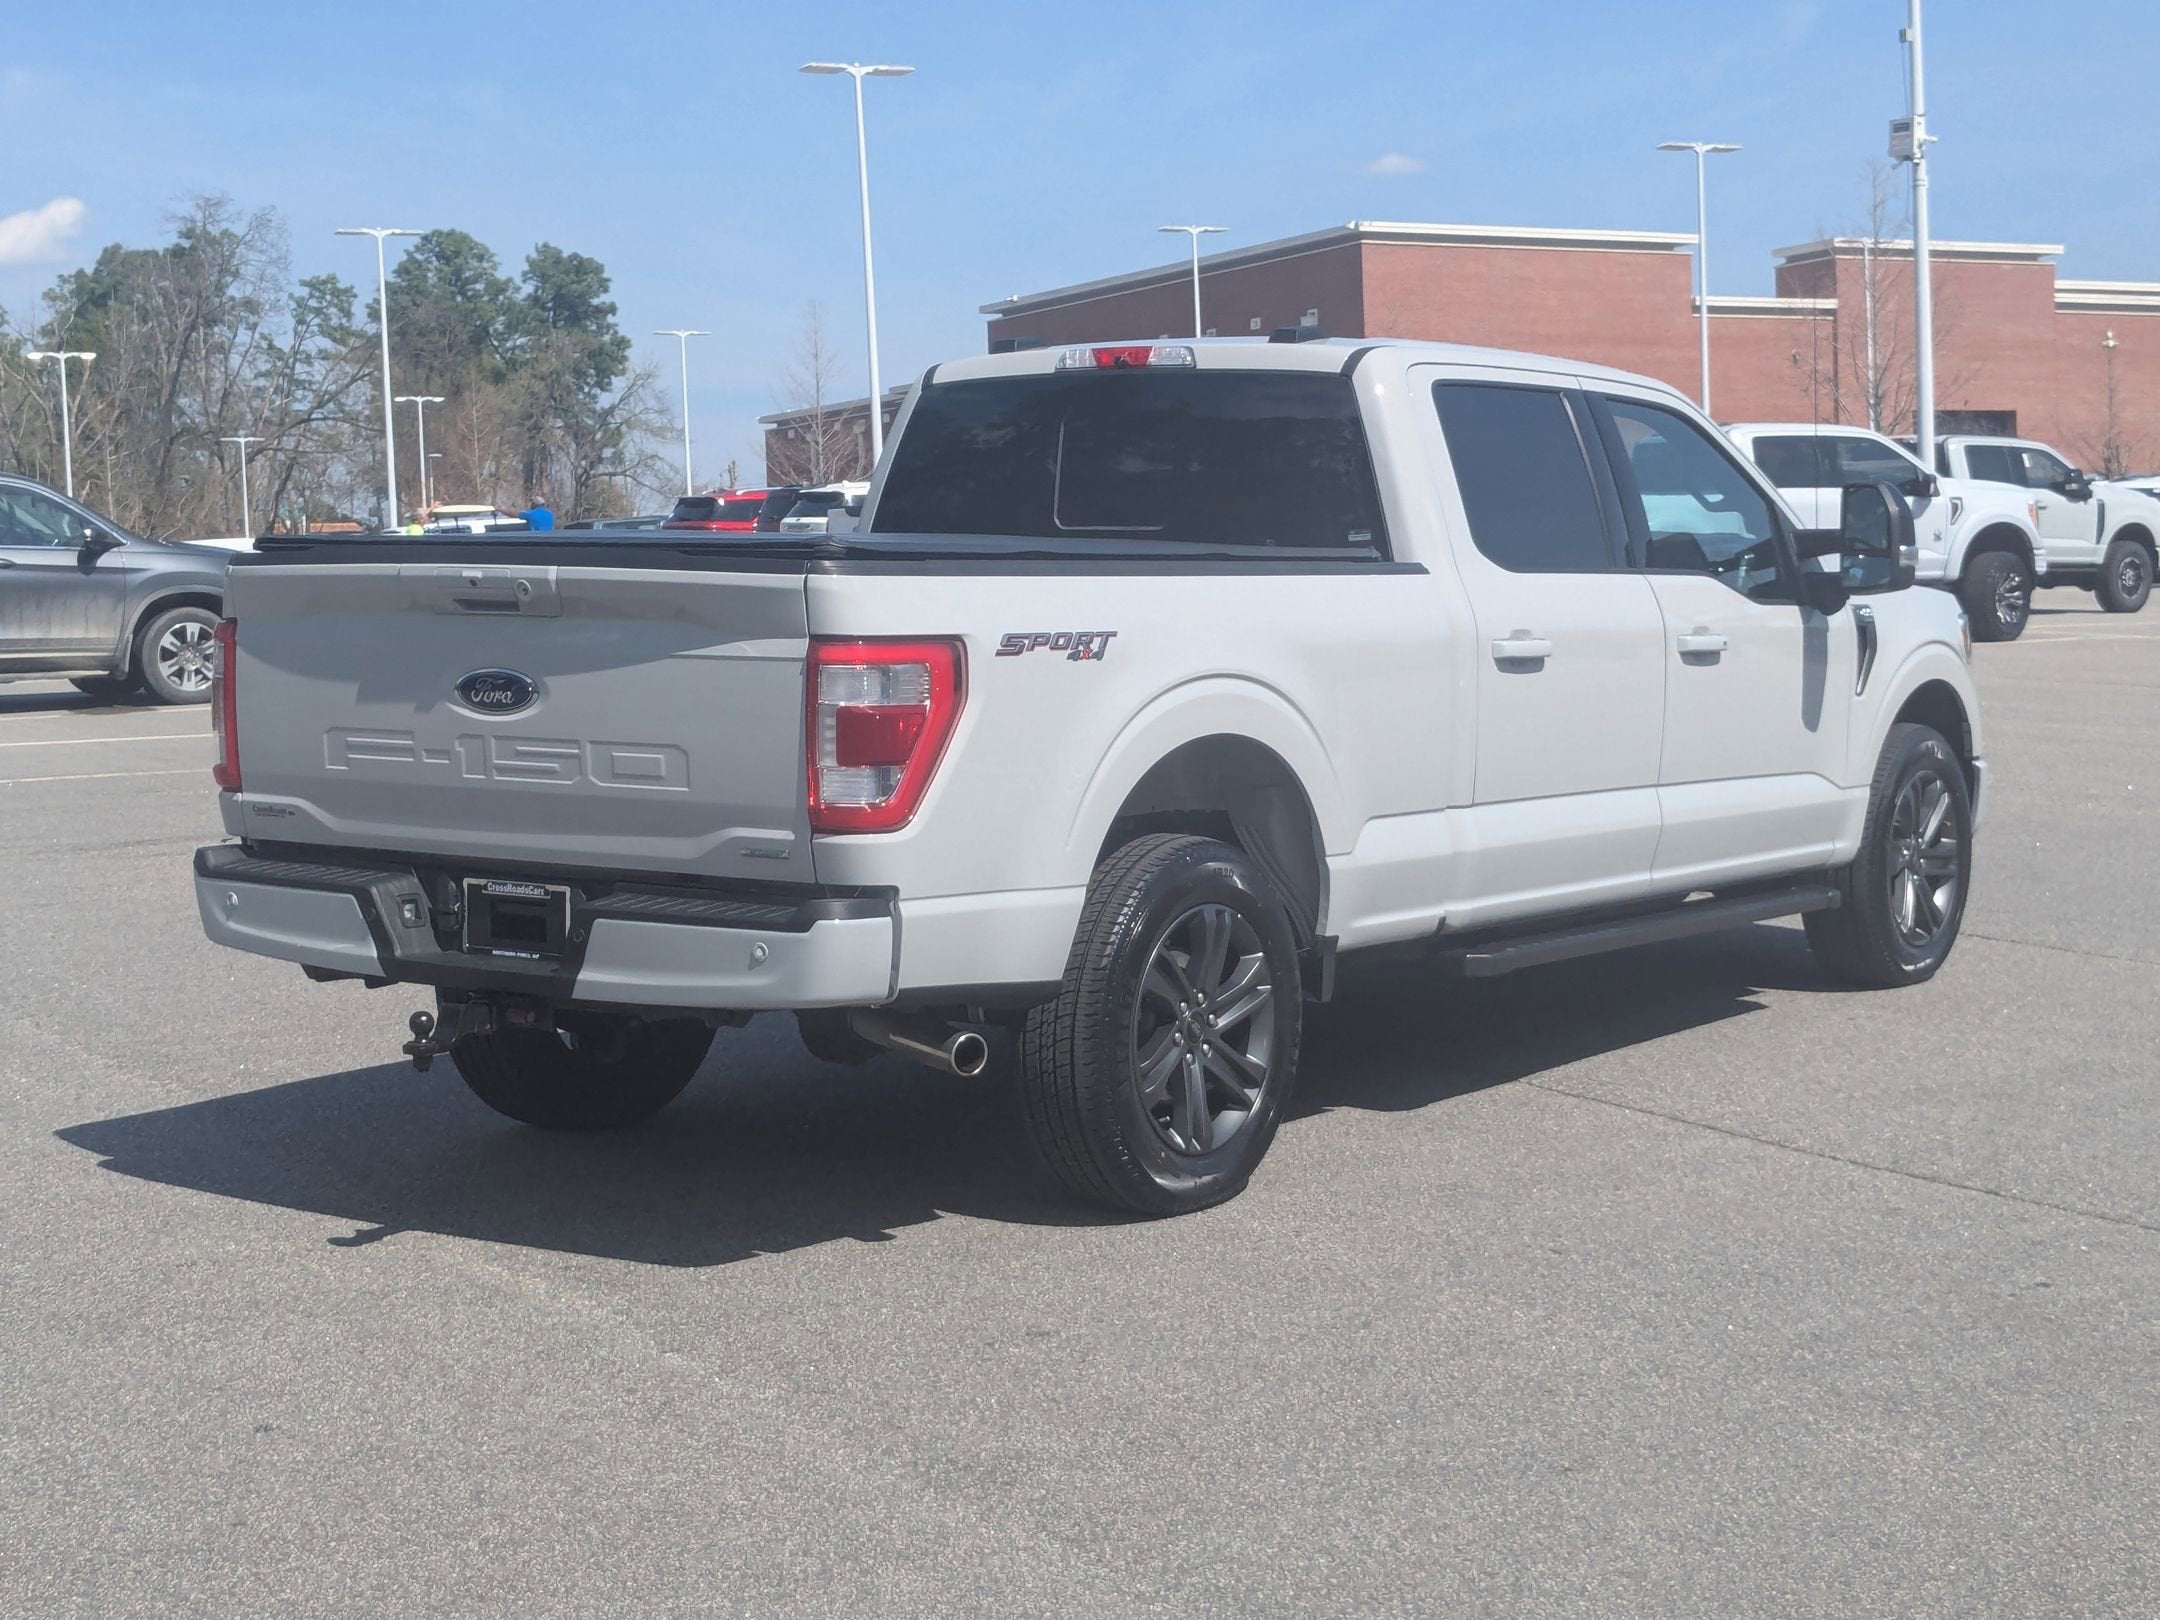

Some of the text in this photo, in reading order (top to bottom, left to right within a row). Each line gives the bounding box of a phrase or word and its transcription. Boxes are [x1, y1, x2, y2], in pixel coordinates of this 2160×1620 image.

[994, 630, 1118, 657] SPORT
[471, 677, 517, 704] Ford
[323, 726, 690, 792] F-150
